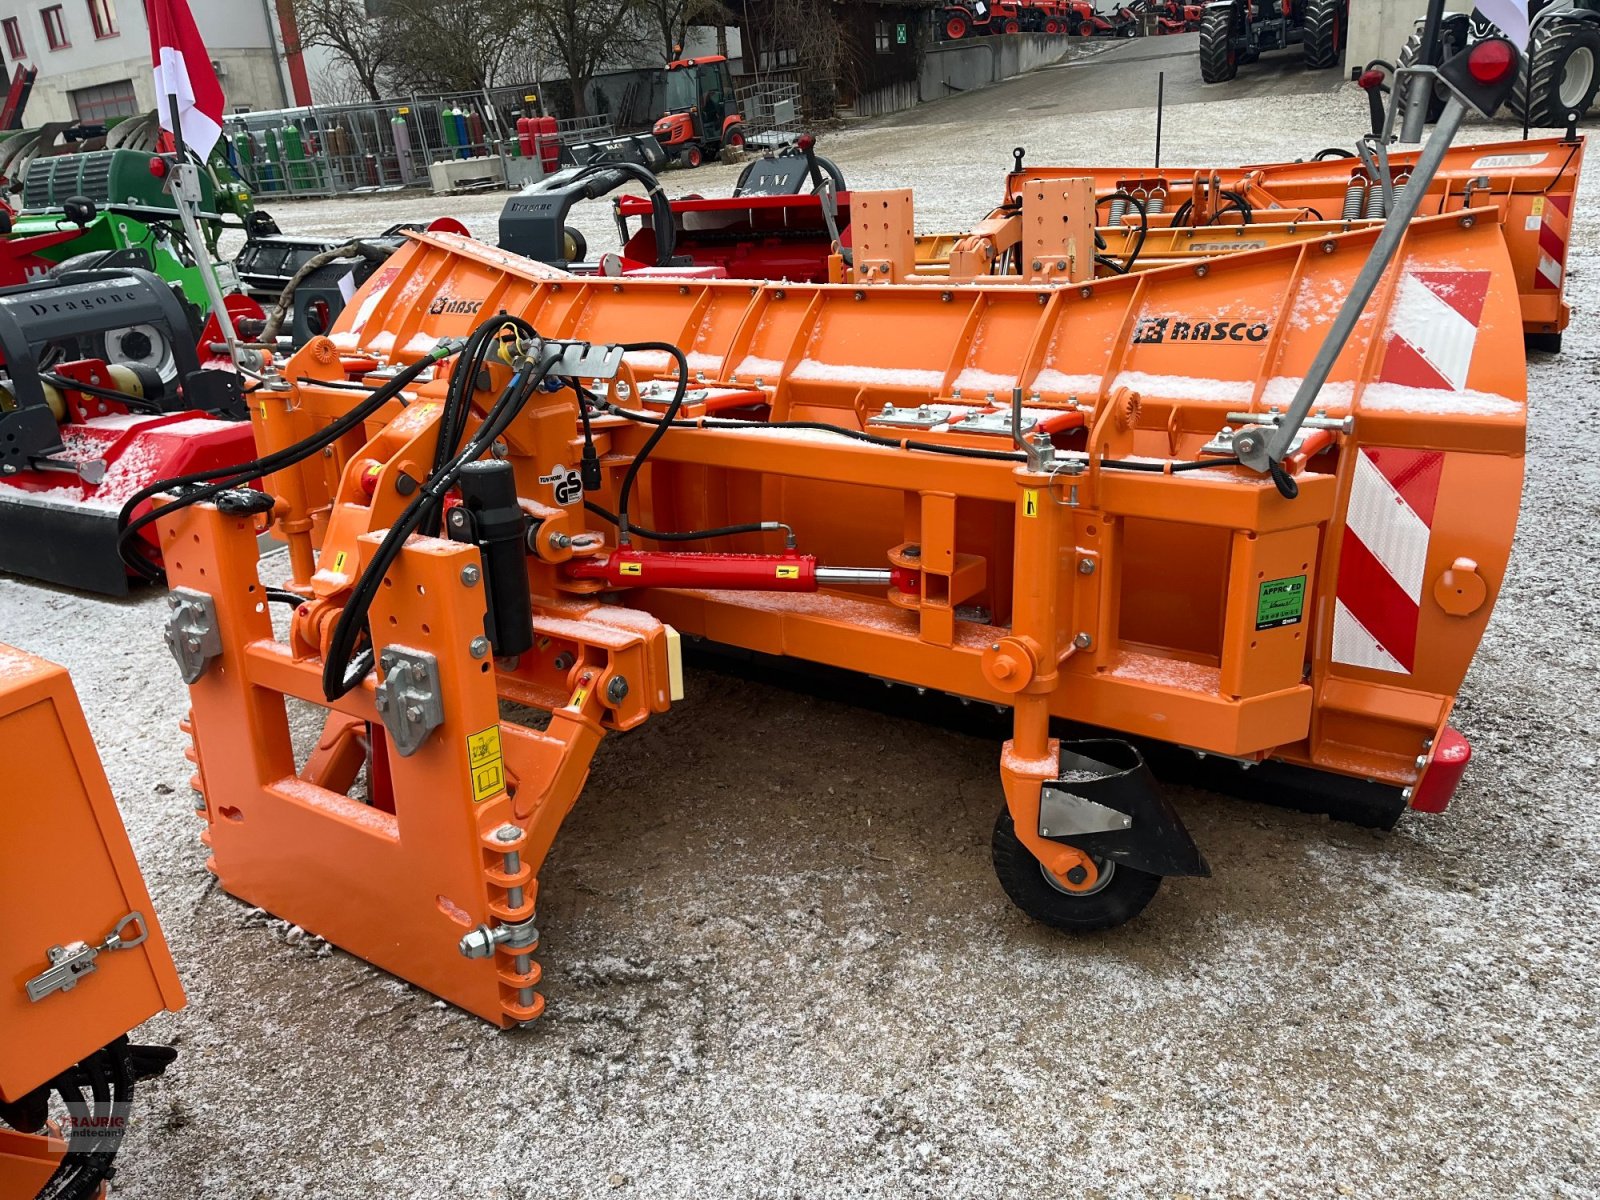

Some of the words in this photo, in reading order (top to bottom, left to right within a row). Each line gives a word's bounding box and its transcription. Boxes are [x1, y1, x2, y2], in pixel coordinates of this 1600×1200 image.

[759, 173, 790, 186] VM
[511, 202, 553, 212] Dragone
[29, 292, 136, 316] Dragone
[445, 300, 484, 315] RASC
[1170, 321, 1269, 343] RASCO
[555, 471, 582, 504] GS
